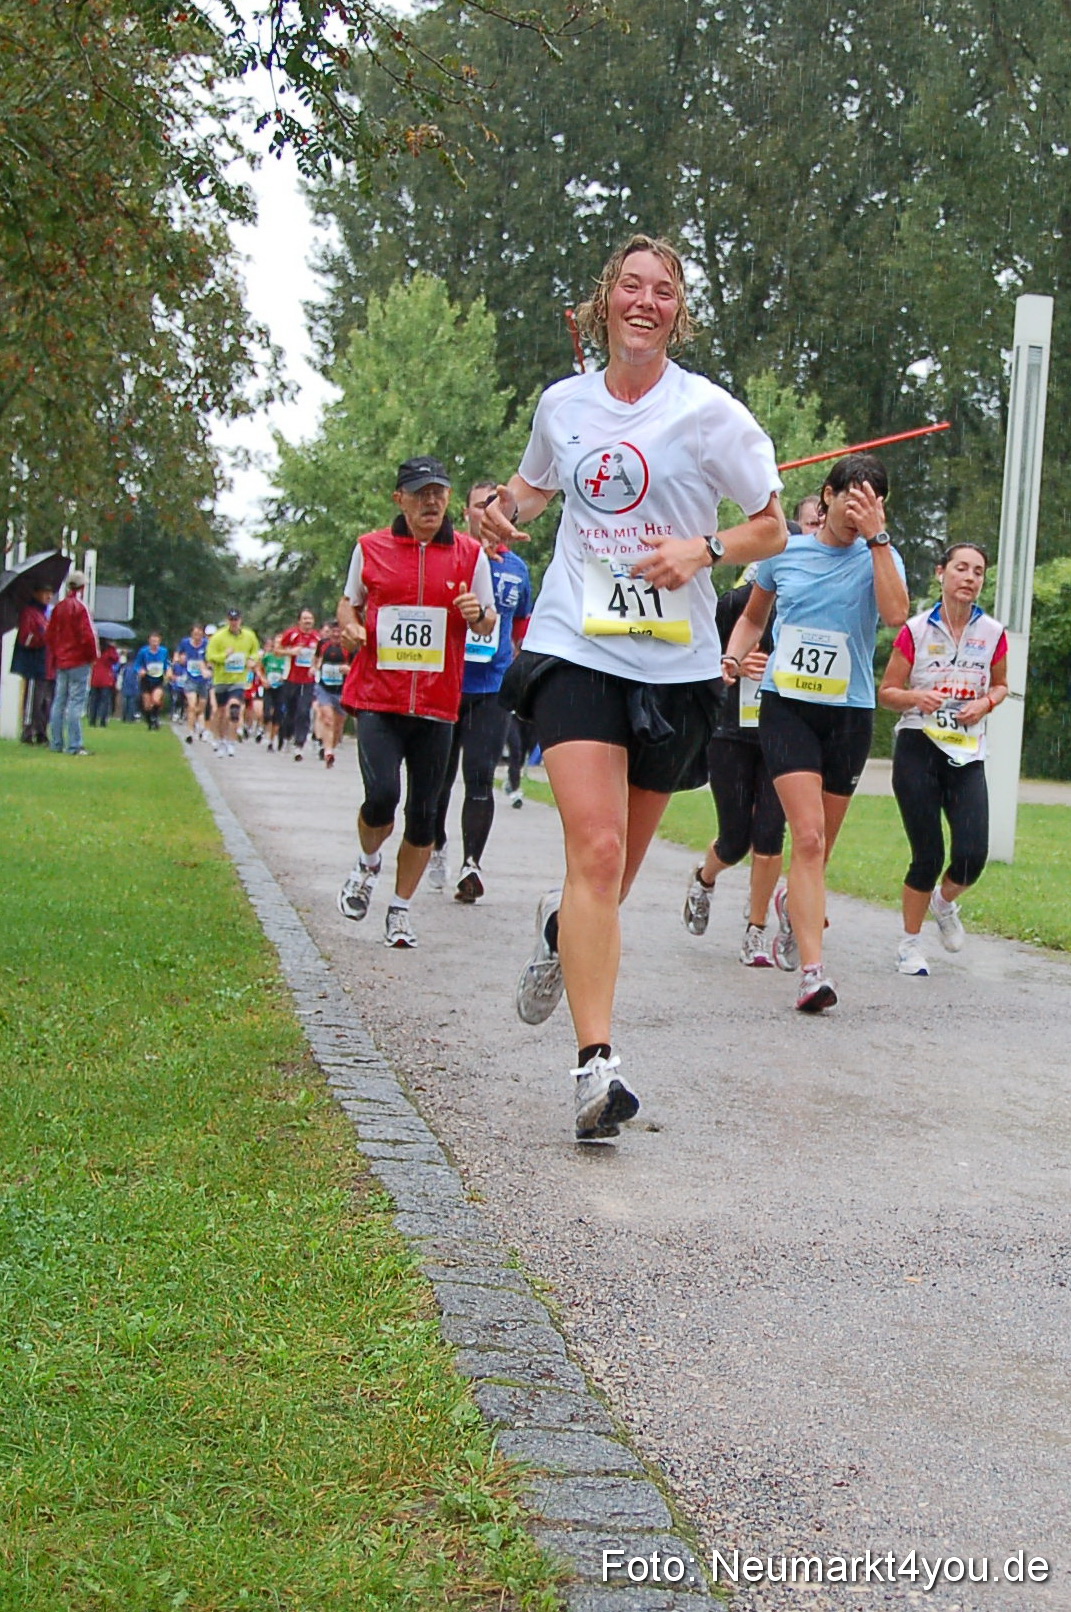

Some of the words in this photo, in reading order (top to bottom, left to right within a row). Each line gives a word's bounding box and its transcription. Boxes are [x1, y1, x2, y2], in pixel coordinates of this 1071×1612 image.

[614, 527, 638, 538] MIT
[607, 582, 664, 618] 411
[390, 623, 432, 647] 468
[790, 647, 838, 676] 437
[795, 677, 823, 692] Lucia
